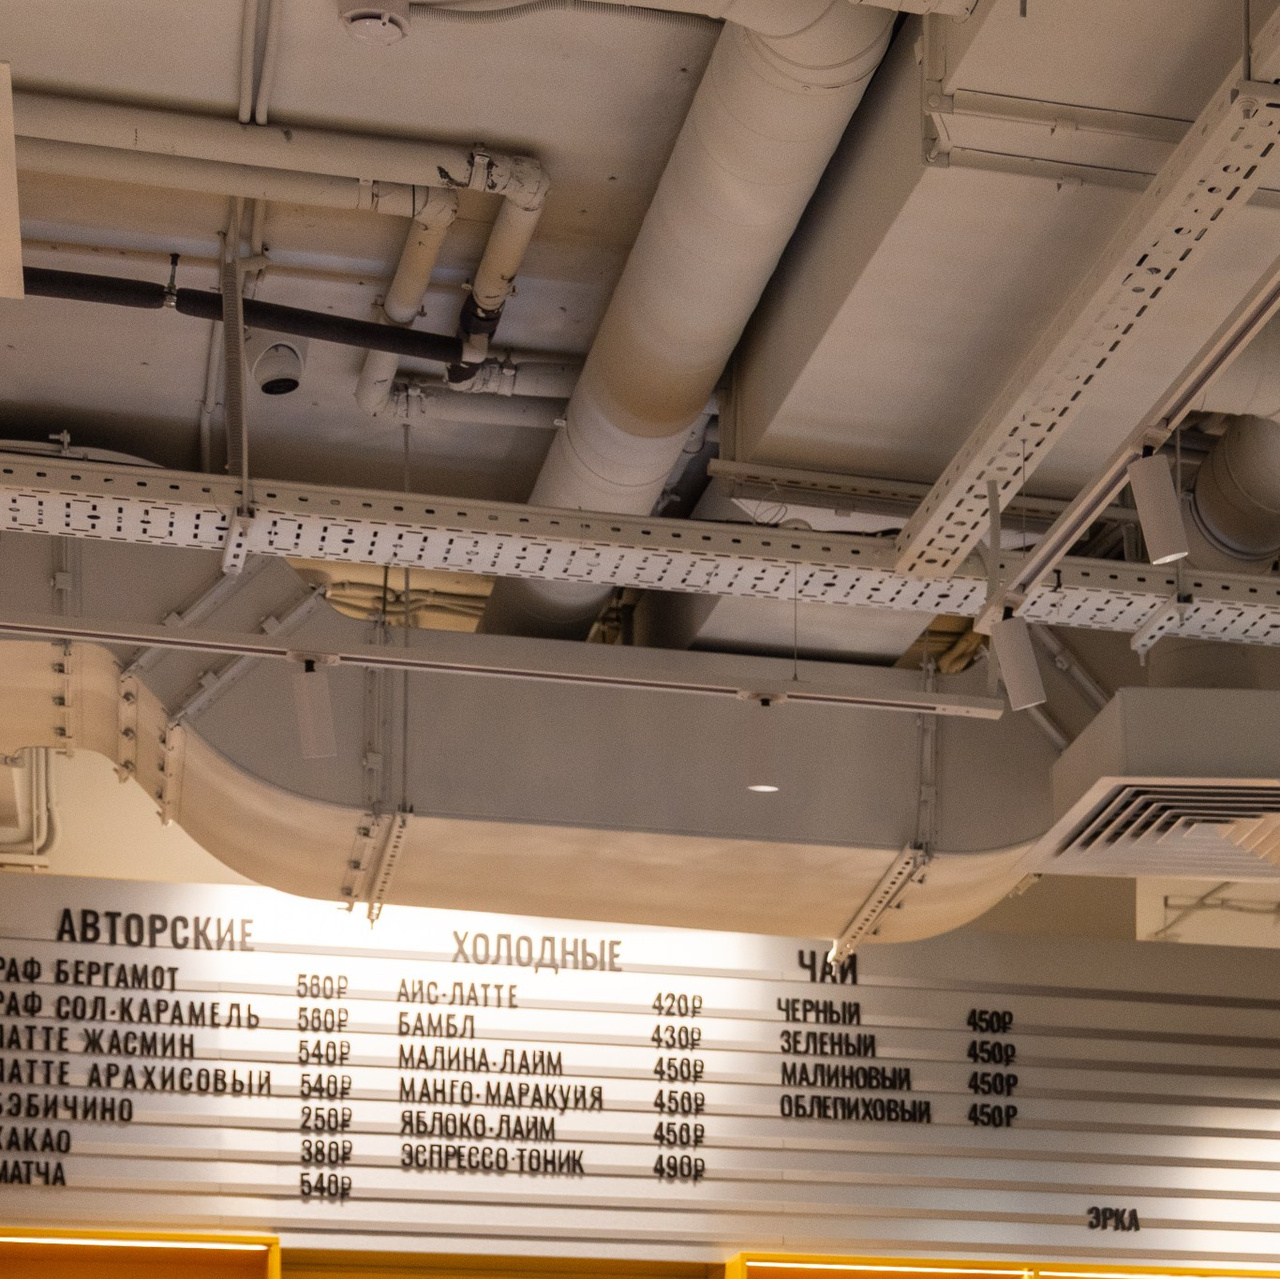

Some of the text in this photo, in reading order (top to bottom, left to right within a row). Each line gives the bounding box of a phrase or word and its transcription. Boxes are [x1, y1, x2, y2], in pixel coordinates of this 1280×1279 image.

[57, 908, 255, 951] АВТОРСКИЕ
[452, 931, 622, 974] ХОЛОДНЫЕ
[797, 950, 858, 985] ЧАЙ
[55, 959, 179, 992] БЕРГАМОТ
[398, 1012, 475, 1039] БАМБЛ
[777, 998, 860, 1025] ЧЕРНЫЙ
[84, 1028, 194, 1060] ЖАСМИН
[780, 1030, 876, 1057] ЗЕЛЕНЫЙ
[88, 1063, 272, 1099] АРАХИСОВЫЙ
[780, 1062, 912, 1091] МАЛИНОВЫЙ
[0, 1092, 133, 1122] ЭБИЧИНО
[780, 1094, 932, 1124] ОБЛЕПИХОВЫЙ
[0, 1127, 71, 1154] АКАО
